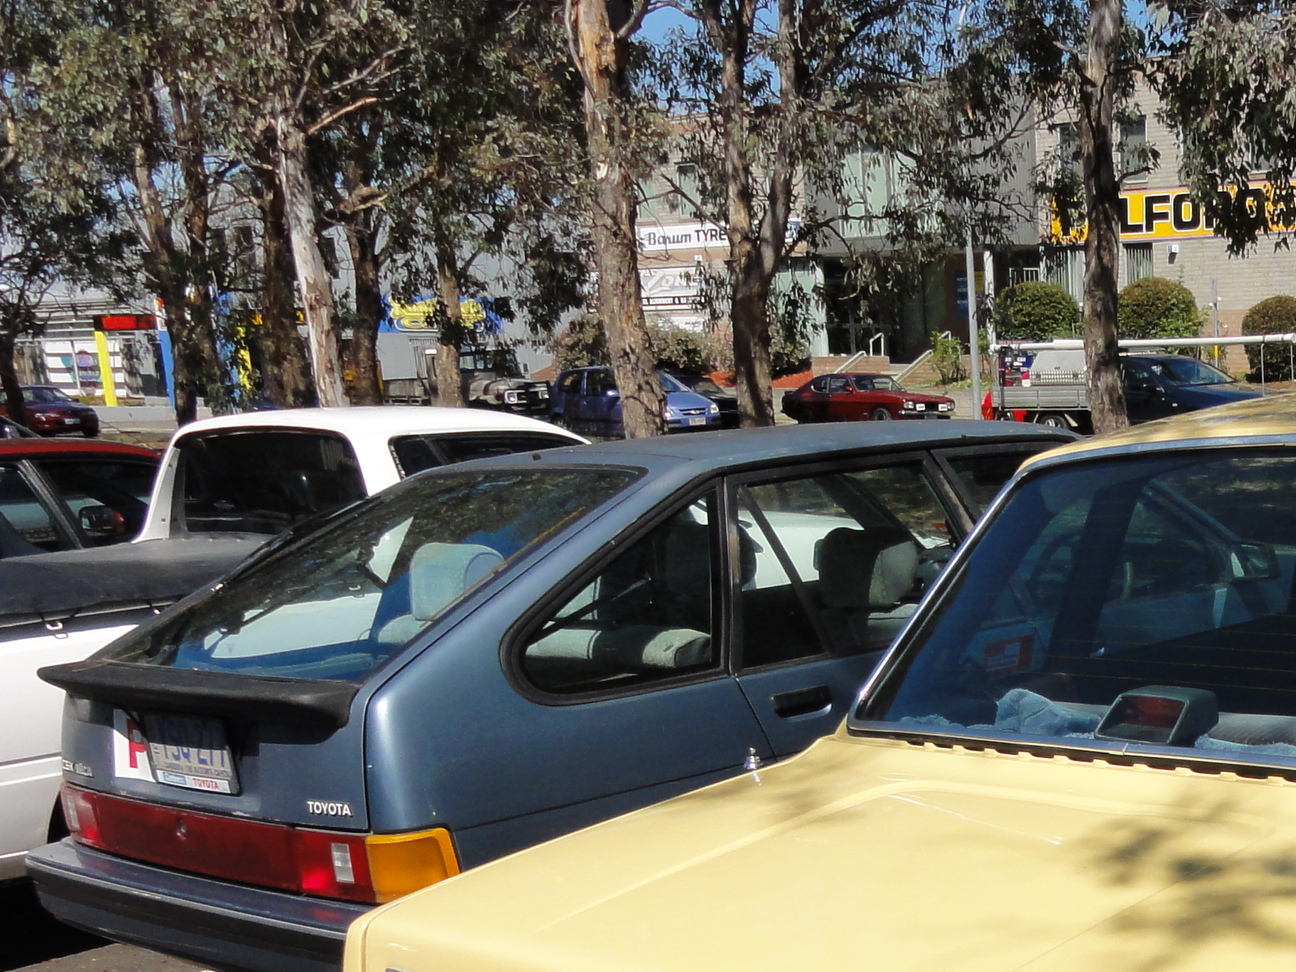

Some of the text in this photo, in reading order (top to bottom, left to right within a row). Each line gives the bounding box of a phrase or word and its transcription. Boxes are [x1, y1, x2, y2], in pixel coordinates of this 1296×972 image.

[647, 230, 692, 246] Barum
[192, 777, 220, 790] TOYOTA
[307, 800, 353, 817] TOYOTA
